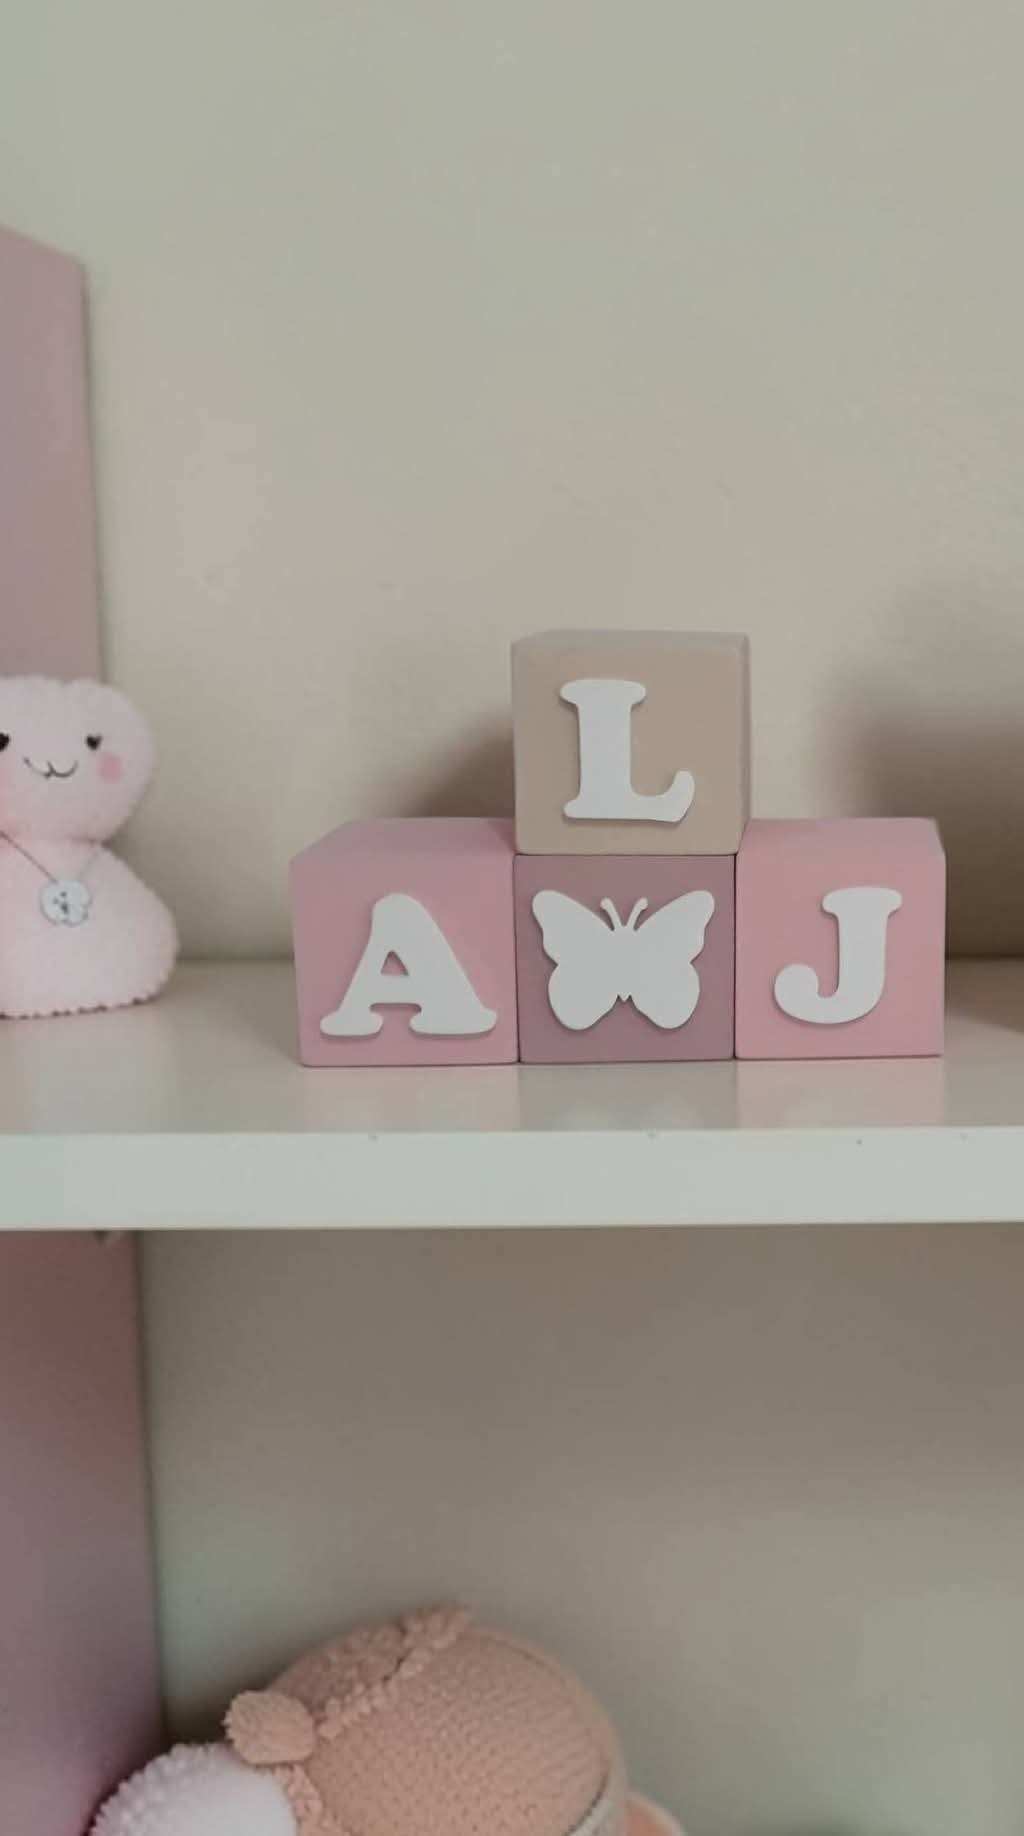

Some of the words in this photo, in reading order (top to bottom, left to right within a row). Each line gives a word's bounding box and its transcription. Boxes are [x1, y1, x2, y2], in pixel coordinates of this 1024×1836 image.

[560, 678, 696, 823] L
[319, 893, 497, 1038] A
[773, 886, 903, 1025] J
